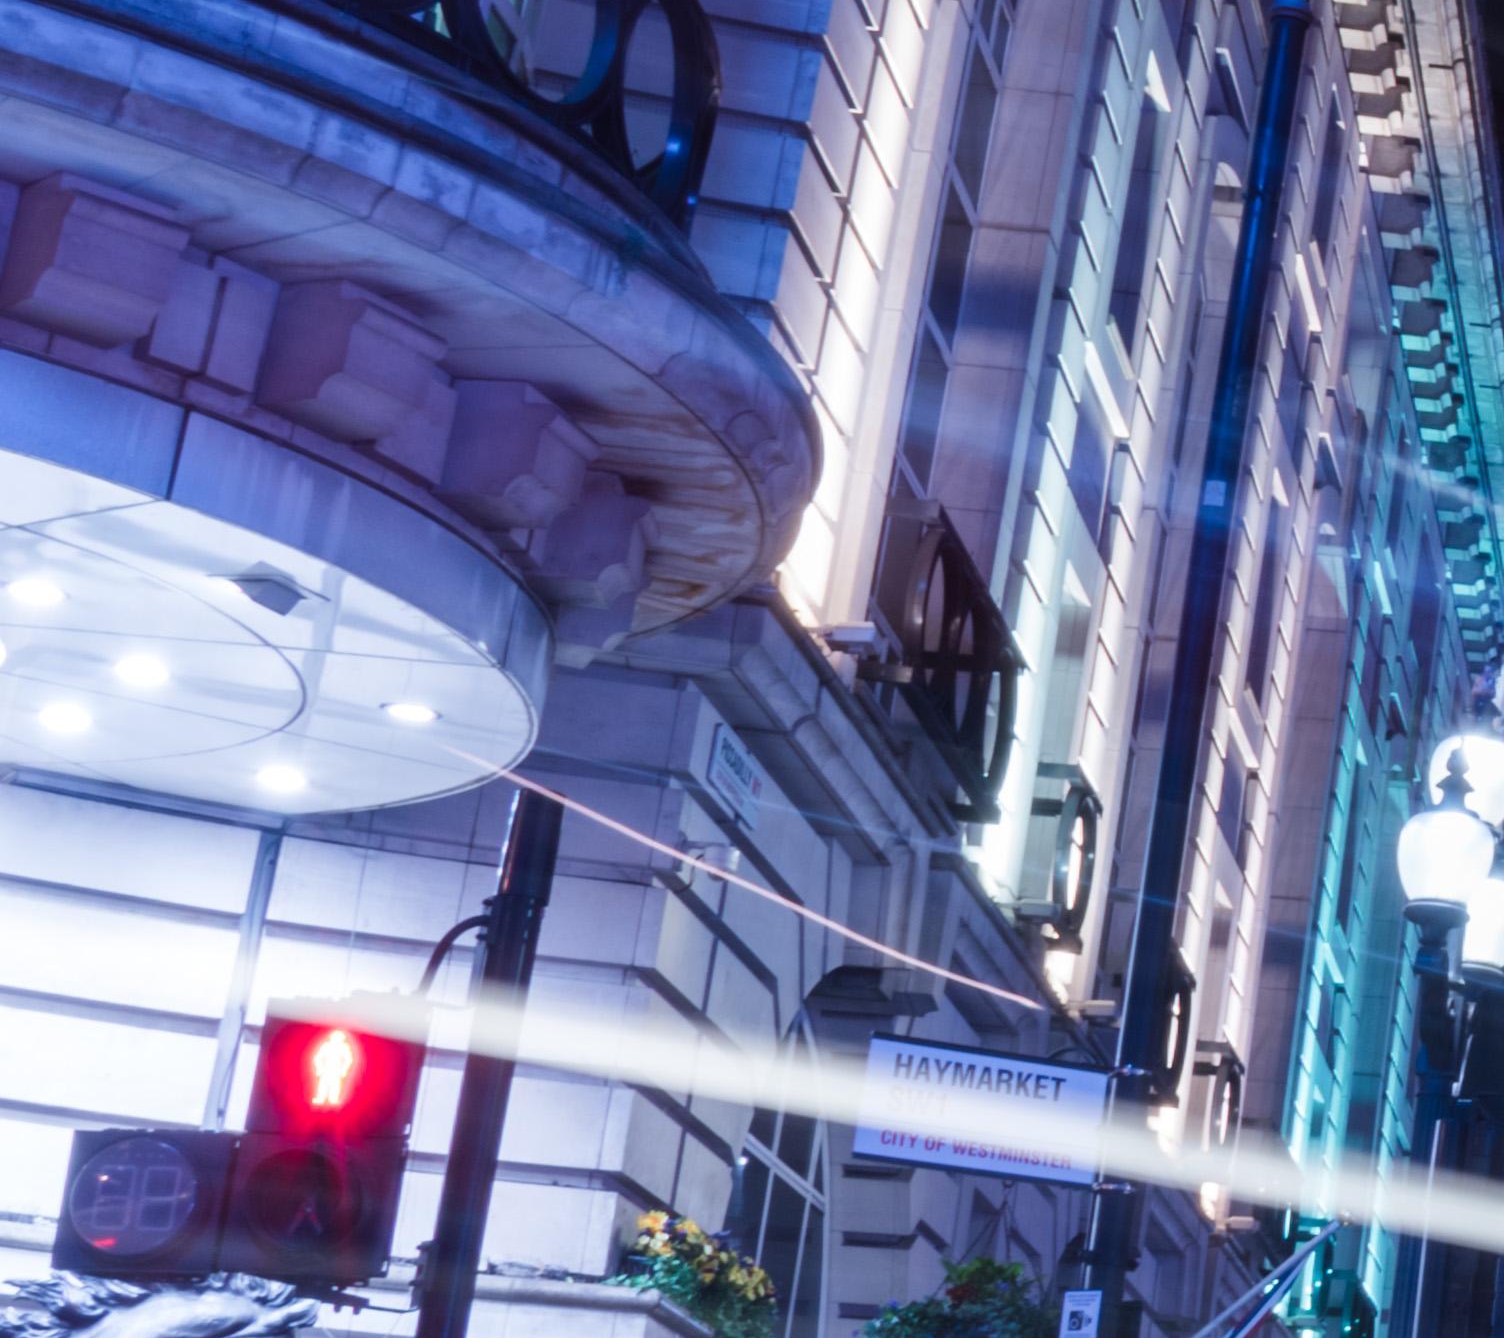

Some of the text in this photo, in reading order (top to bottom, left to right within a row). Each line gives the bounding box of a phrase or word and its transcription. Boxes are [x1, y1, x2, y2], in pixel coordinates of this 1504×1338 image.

[894, 1052, 1066, 1102] HAYMARKET
[880, 1129, 1071, 1170] CITY OF WESTMINSTER
